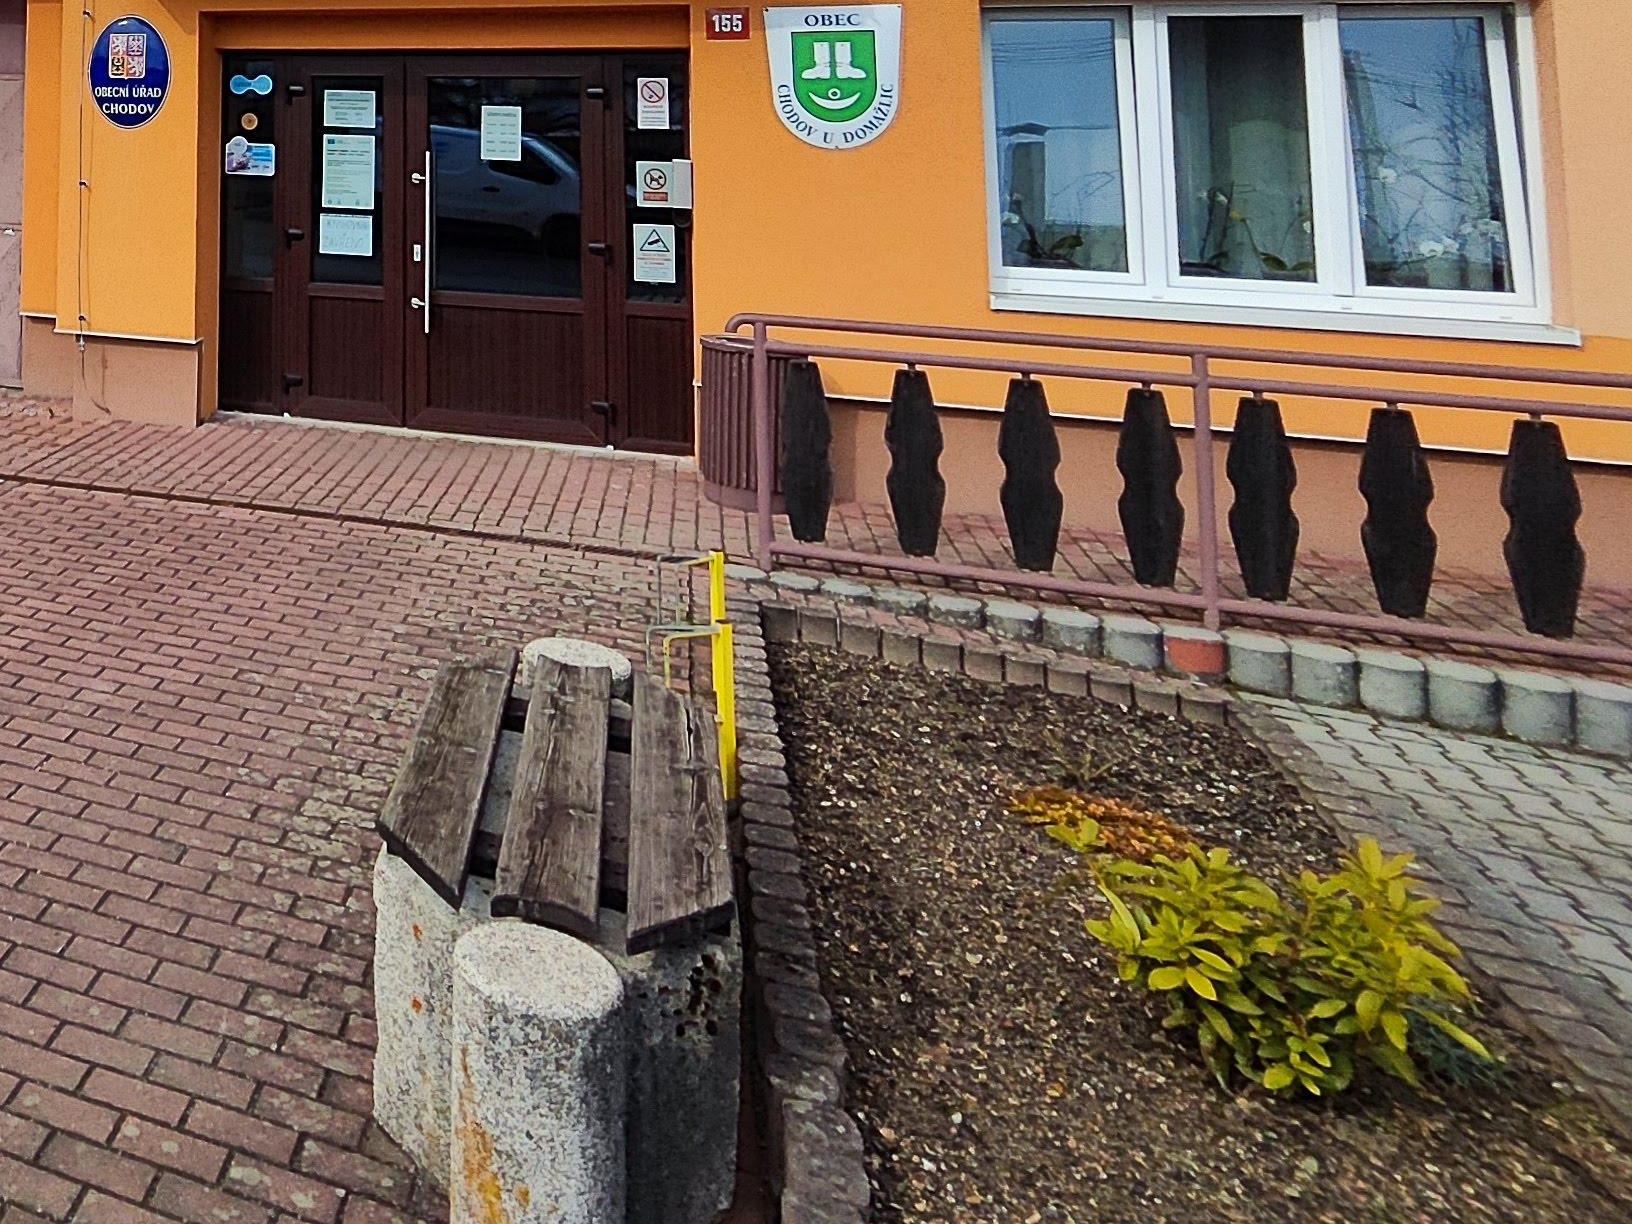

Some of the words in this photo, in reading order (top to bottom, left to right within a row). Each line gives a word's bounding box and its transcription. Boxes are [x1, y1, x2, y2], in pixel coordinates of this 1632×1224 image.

[712, 14, 743, 33] 155
[804, 13, 861, 27] OBEC
[94, 83, 130, 98] OBECNÍ
[132, 84, 162, 98] ÚŘAD
[102, 103, 155, 115] CHODOV
[777, 84, 819, 138] CHODOV
[823, 132, 835, 144] U
[842, 83, 894, 144] DOMAŽLIC
